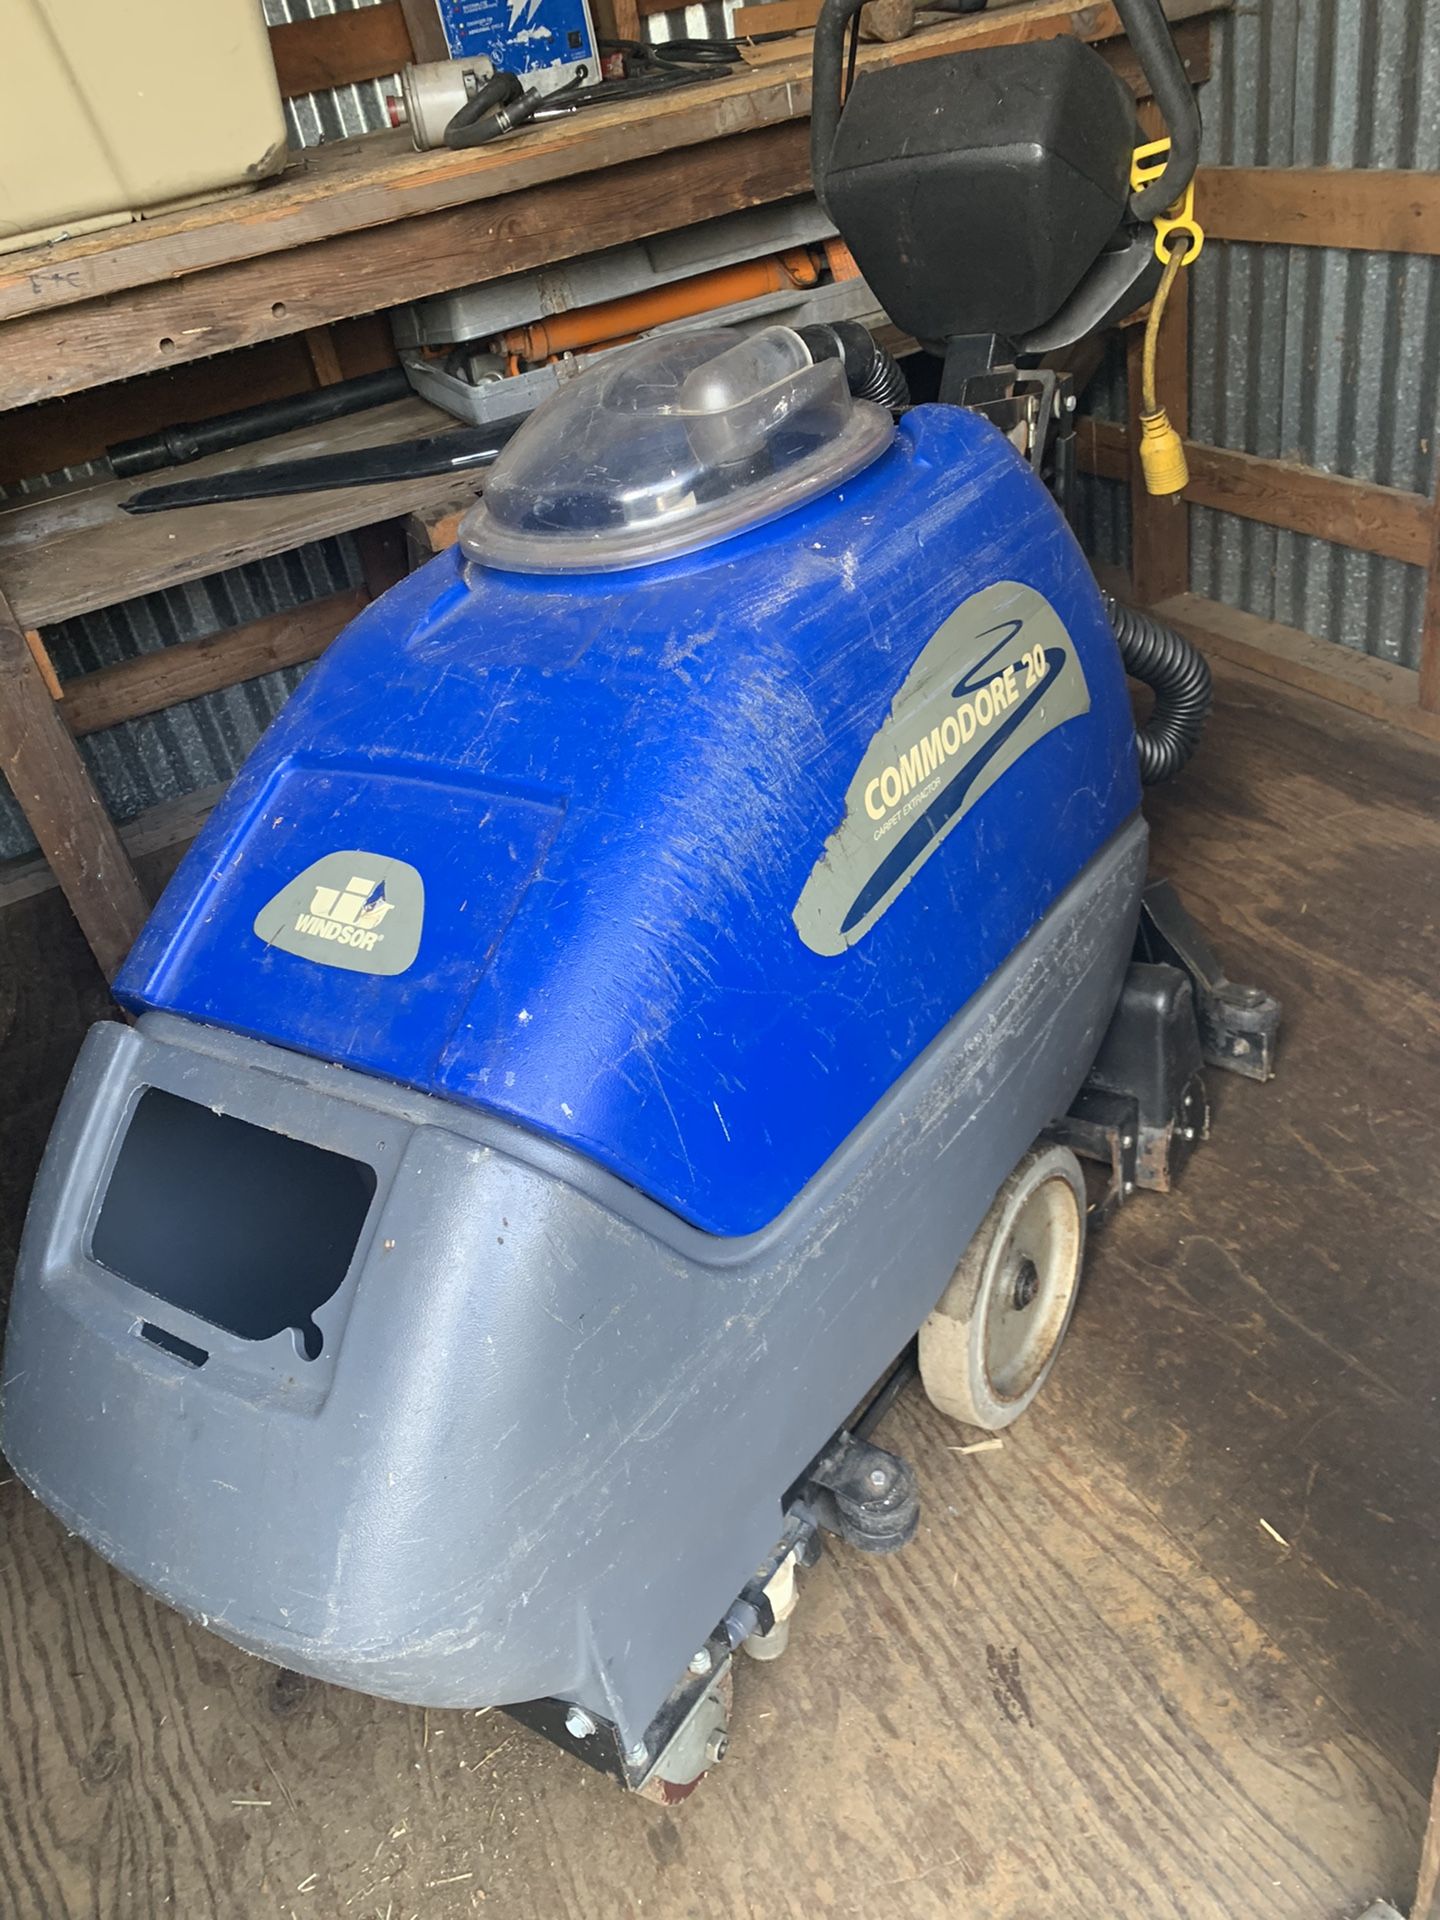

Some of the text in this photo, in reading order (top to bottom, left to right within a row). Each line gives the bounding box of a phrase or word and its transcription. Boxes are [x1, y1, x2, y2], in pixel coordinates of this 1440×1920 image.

[864, 643, 1047, 821] COMMODORE 20
[873, 776, 942, 841] CARPET EXTRACTOR
[294, 913, 380, 951] WINDSOR
